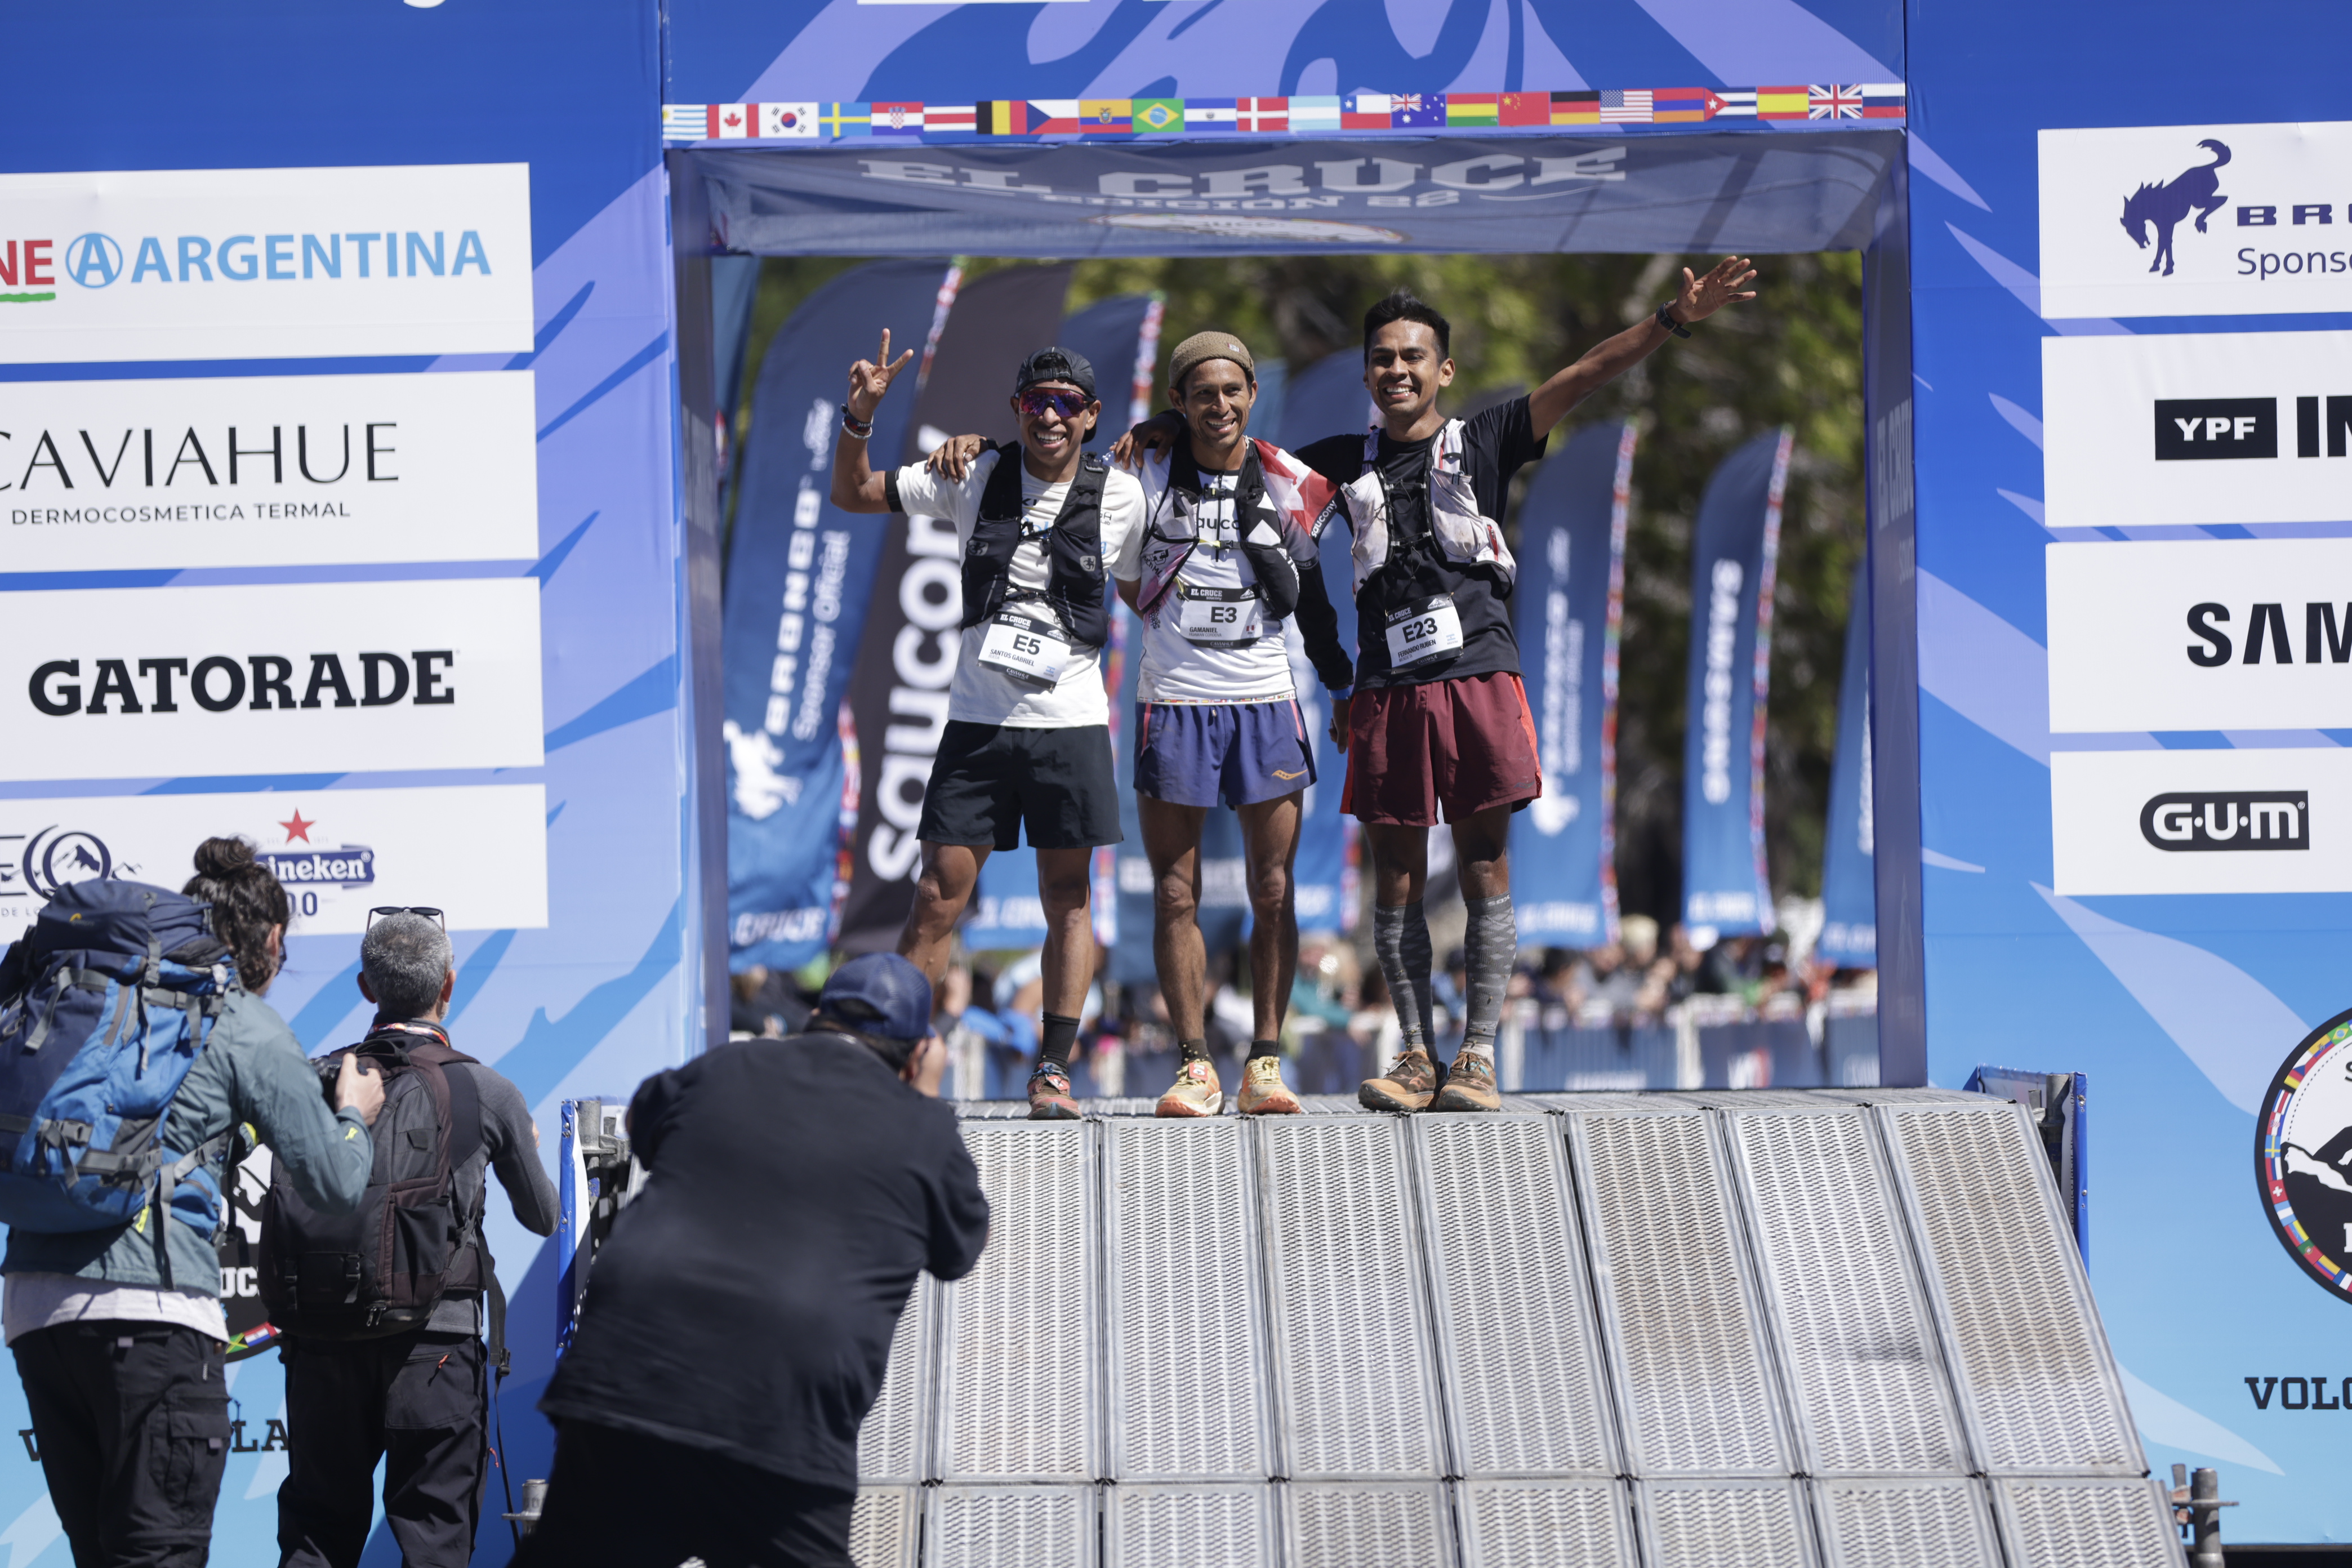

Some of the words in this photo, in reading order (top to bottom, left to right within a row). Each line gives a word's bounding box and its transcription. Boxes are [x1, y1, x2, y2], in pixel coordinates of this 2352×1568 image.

[2237, 204, 2352, 226] BR
[131, 230, 492, 283] ARGENTINA
[2237, 247, 2352, 281] Spons
[2174, 416, 2256, 442] YPF
[0, 422, 399, 491] AVIAHUE
[11, 504, 244, 525] DERMOCOSMETICA
[256, 502, 351, 520] TERMAL
[1198, 517, 1239, 529] auco
[1311, 500, 1338, 538] saucony
[1009, 615, 1031, 626] CRUCE
[1210, 606, 1237, 623] E3
[1395, 607, 1411, 620] CRUCE
[1402, 617, 1438, 644] E23
[1012, 634, 1041, 655] E5
[1397, 644, 1420, 658] FERNANDO
[1419, 639, 1436, 649] RUBEN
[990, 649, 1012, 659] SANTOS
[1012, 654, 1035, 666] GABRIEL
[28, 649, 455, 718] GATORADE
[256, 853, 367, 881] ineken
